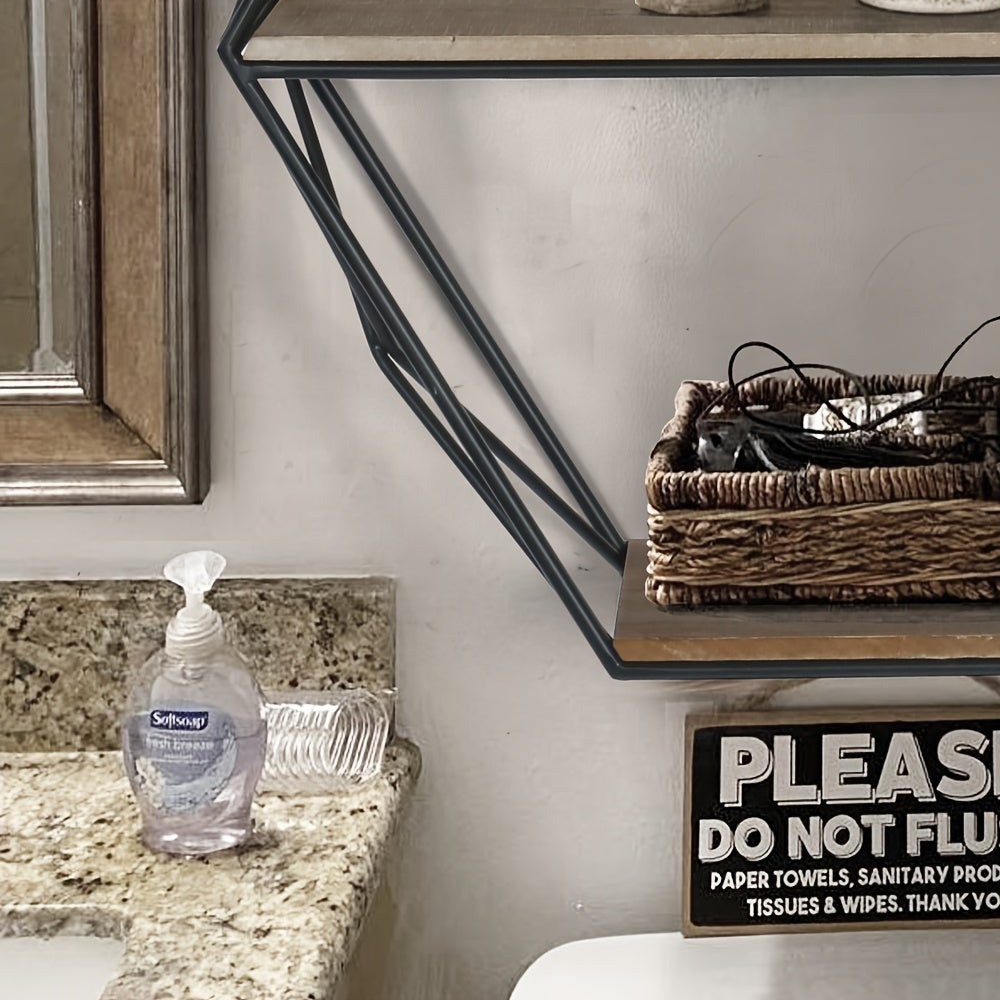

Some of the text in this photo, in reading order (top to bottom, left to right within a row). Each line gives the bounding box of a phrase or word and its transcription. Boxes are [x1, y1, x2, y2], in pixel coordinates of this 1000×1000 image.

[152, 711, 205, 730] Softsoap
[698, 816, 775, 863] DO
[788, 813, 896, 860] NOT
[710, 871, 770, 891] PAPER
[773, 868, 855, 889] TOWELS,
[857, 865, 950, 886] SANITARY
[746, 896, 820, 918] TISSUES
[824, 896, 838, 914] &
[839, 894, 904, 914] WIPES.
[905, 892, 970, 913] THANK
